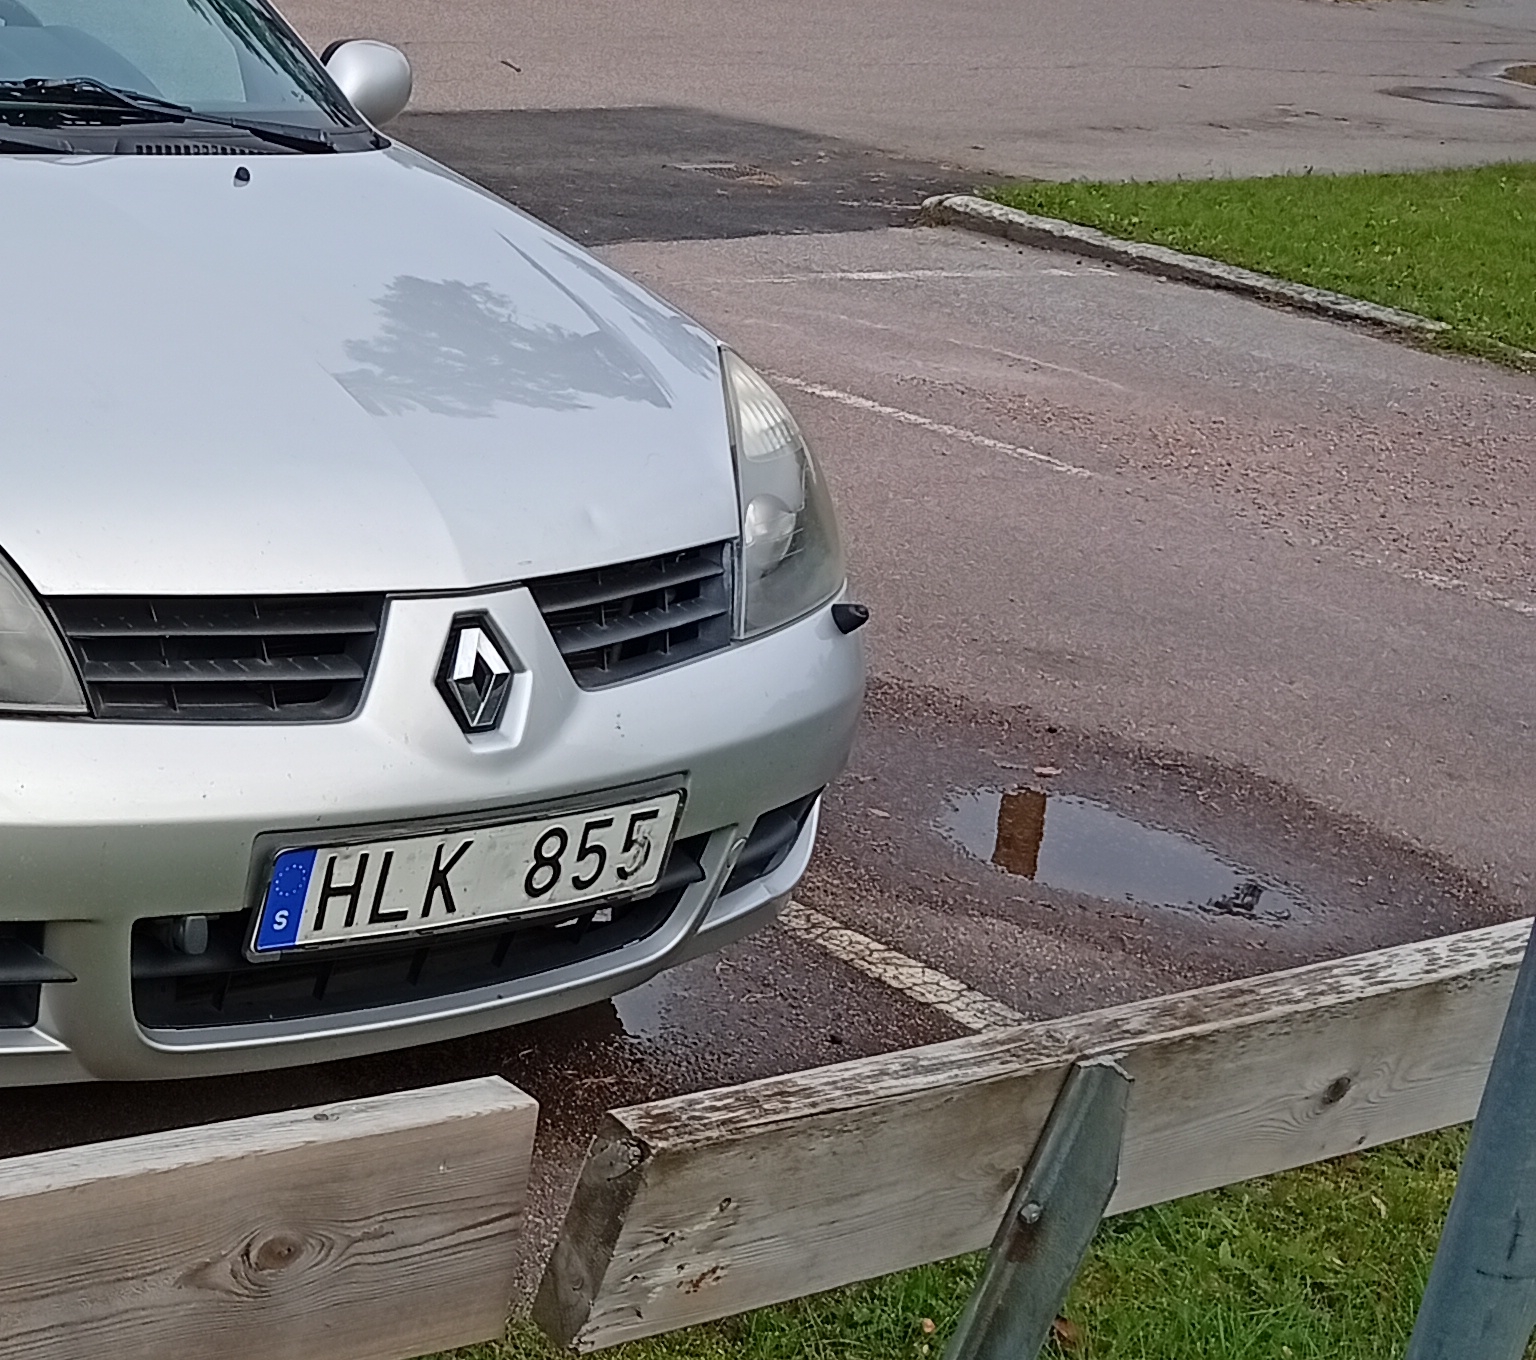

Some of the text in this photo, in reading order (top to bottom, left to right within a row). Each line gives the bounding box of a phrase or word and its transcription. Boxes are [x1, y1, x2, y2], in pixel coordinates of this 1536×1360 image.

[313, 808, 660, 932] HLK 855
[273, 910, 289, 930] S
